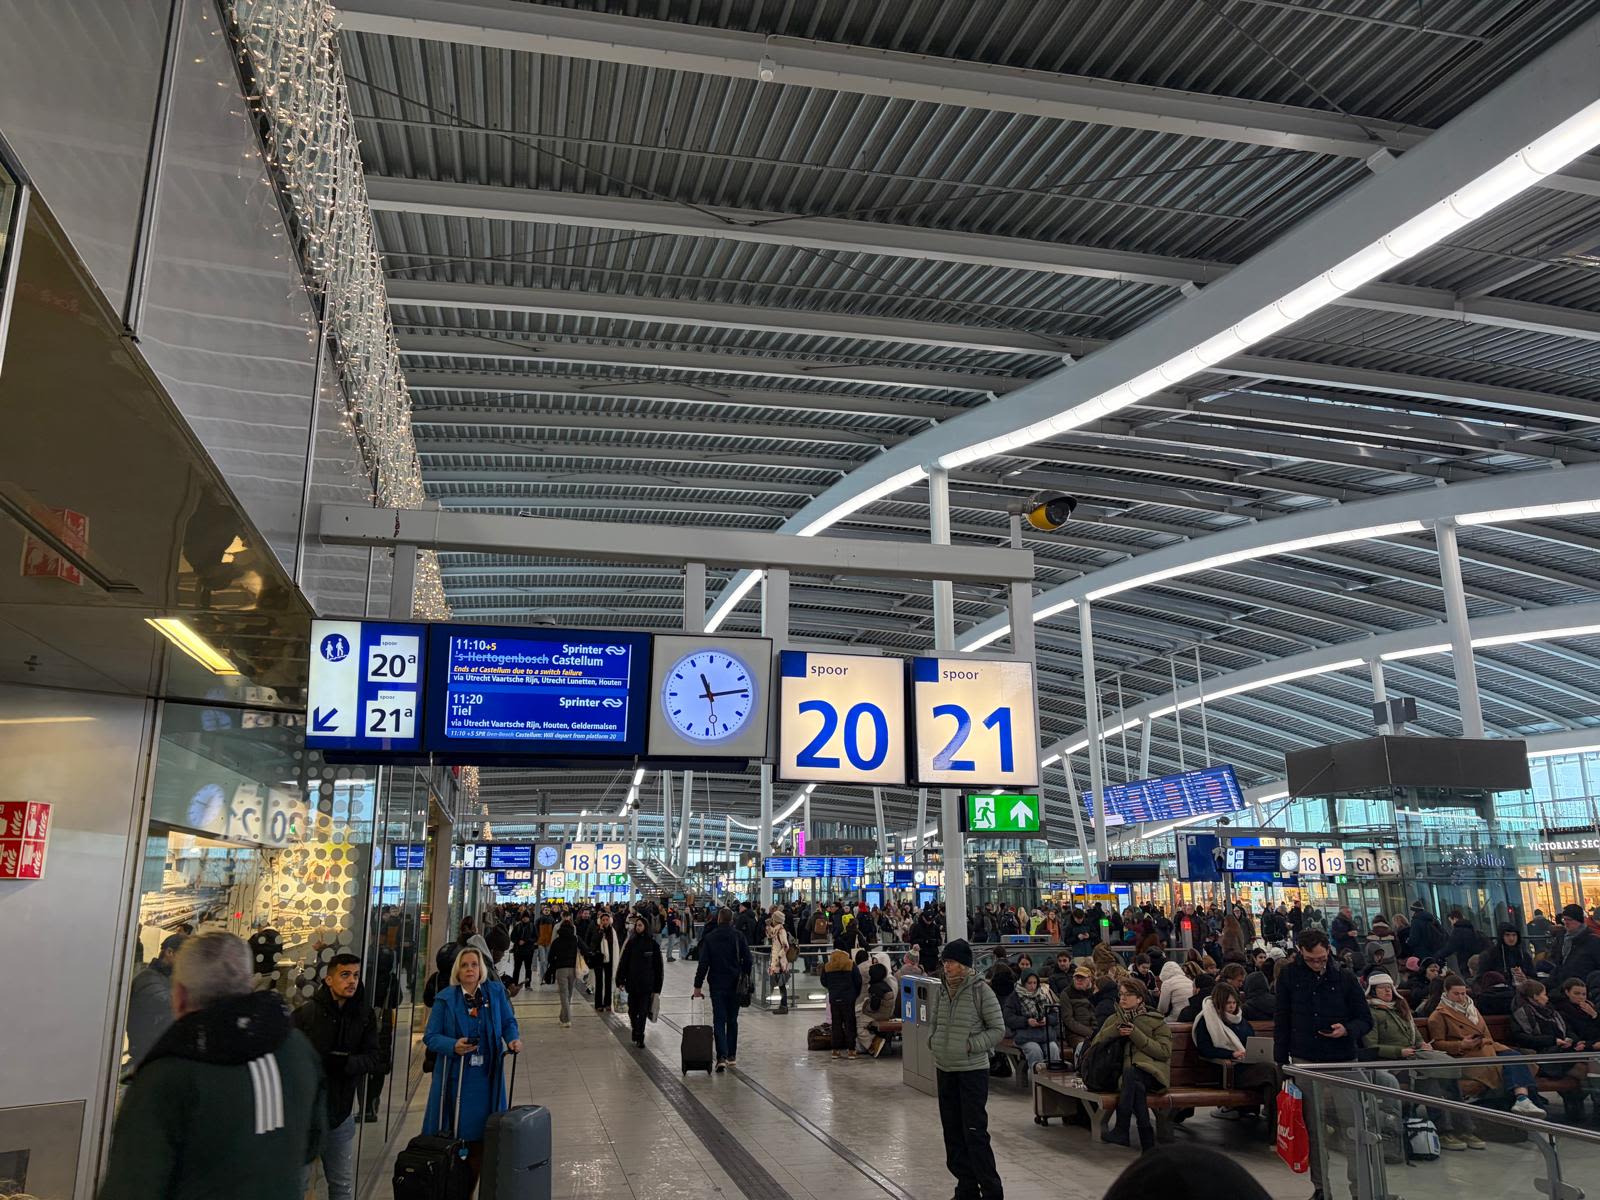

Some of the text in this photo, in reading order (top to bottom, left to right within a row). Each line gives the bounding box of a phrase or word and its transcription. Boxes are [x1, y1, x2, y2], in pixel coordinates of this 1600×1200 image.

[562, 644, 603, 656] Sprinter
[552, 655, 604, 667] Castellum
[479, 666, 511, 675] Castellum
[562, 669, 583, 677] failure
[810, 664, 849, 677] spoor
[942, 668, 979, 682] spoor
[454, 673, 623, 687] via Utrecht Vaartsche Rijn, Utrecht Lunetten, Houten
[453, 693, 484, 705] 11:20
[559, 697, 601, 708] Sprinter
[452, 705, 472, 716] Tiel
[451, 718, 618, 731] via Utrecht Vaartsche Rijn, Houten, Geldermalsen
[555, 732, 573, 740] depart
[586, 733, 608, 741] platform
[796, 699, 889, 771] 20
[932, 704, 1014, 773] 21
[1528, 840, 1579, 851] VICTORIA'S
[570, 854, 590, 871] 18
[602, 854, 621, 870] 19
[1301, 857, 1317, 872] 18
[1326, 857, 1342, 872] 19
[551, 877, 562, 886] 15
